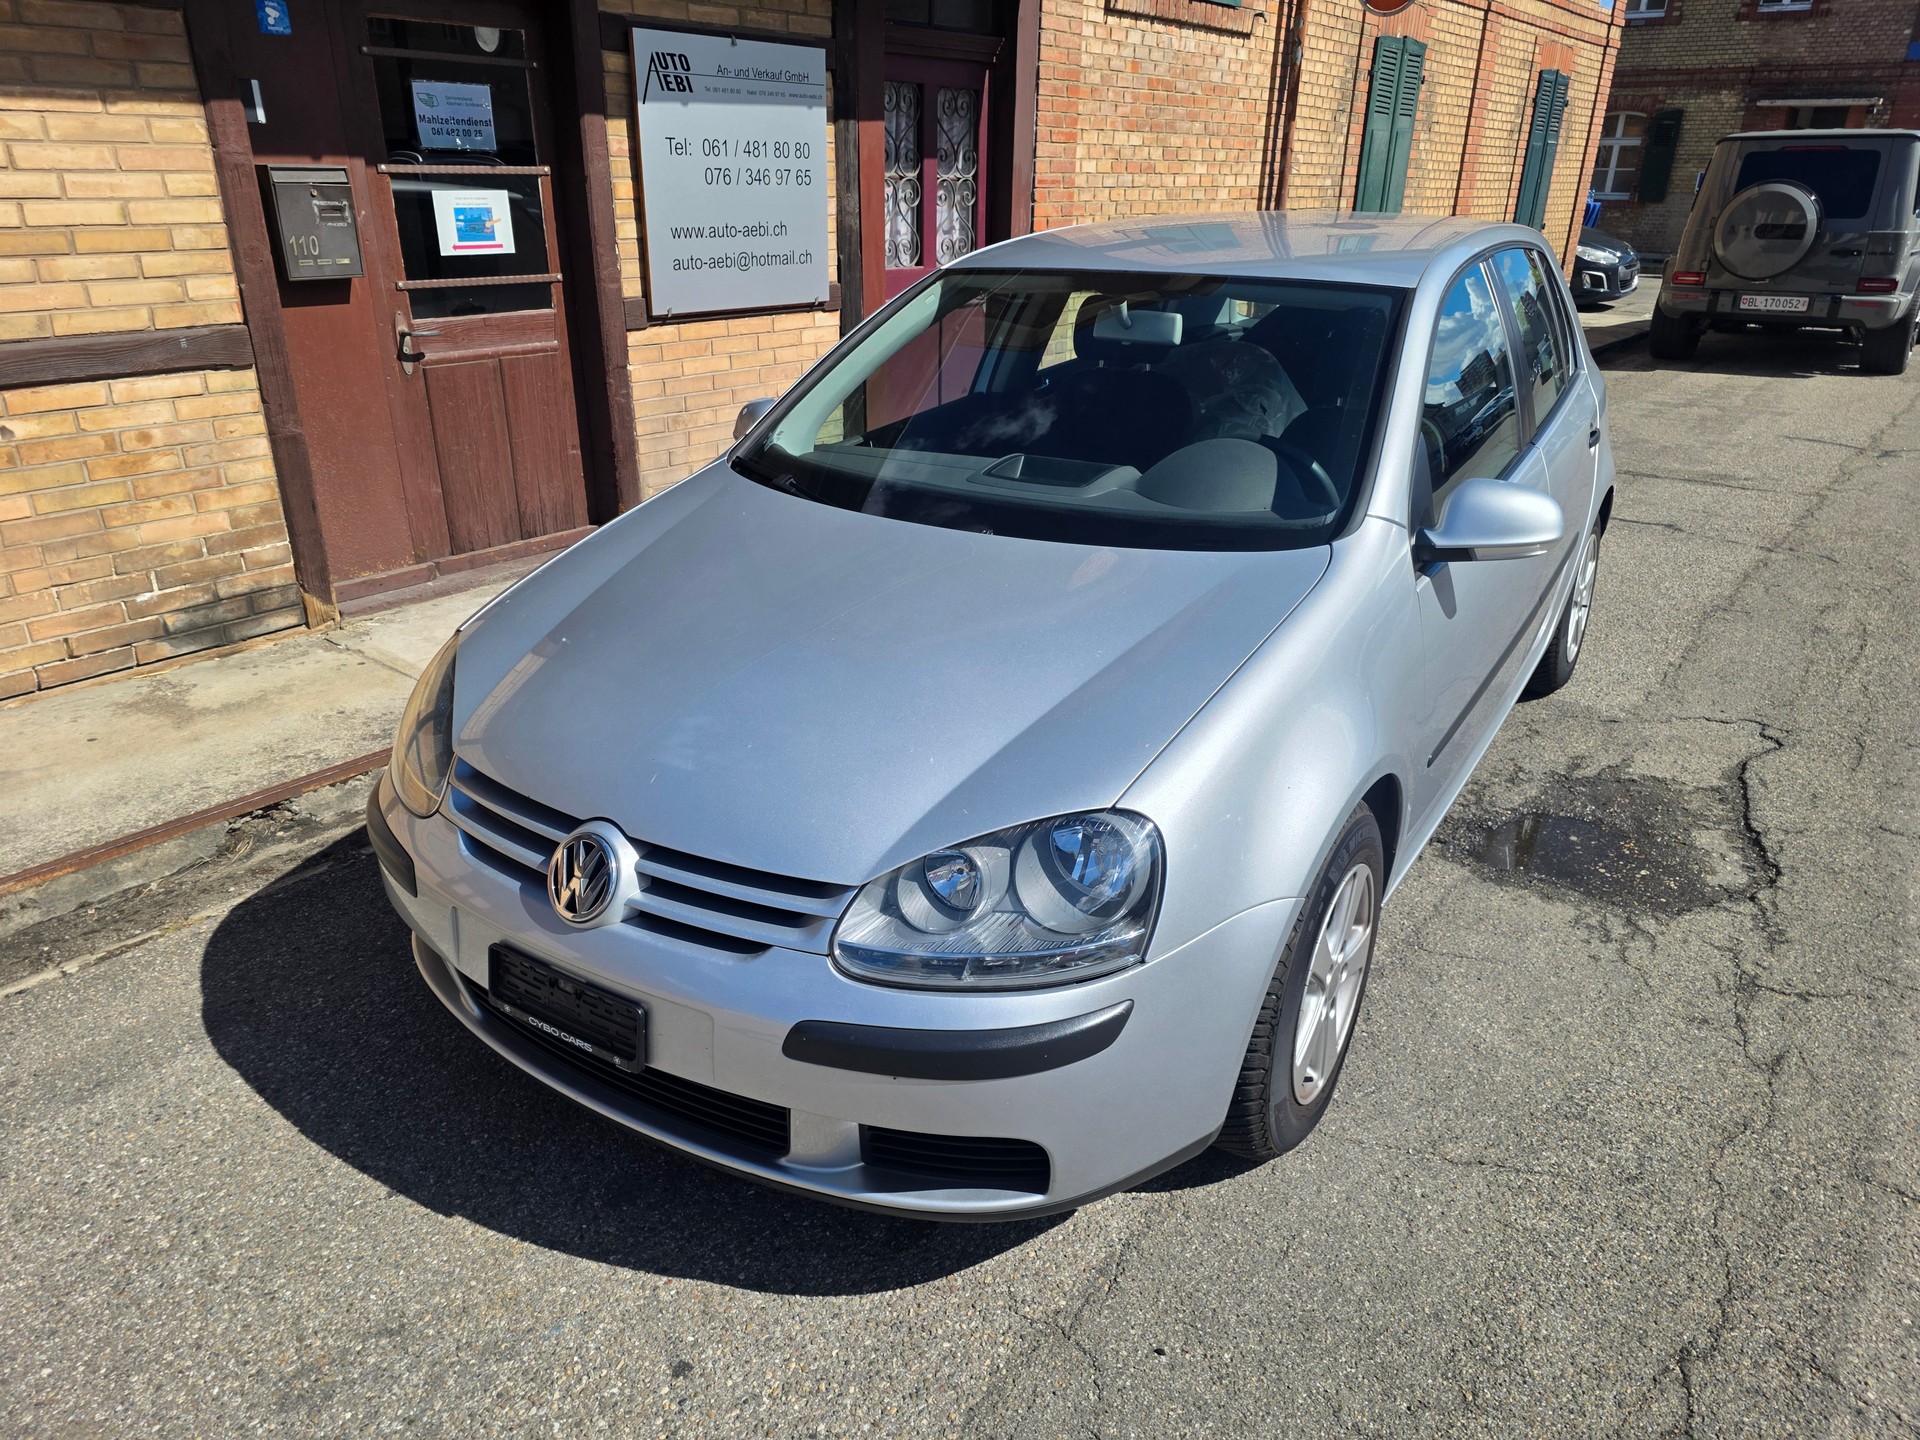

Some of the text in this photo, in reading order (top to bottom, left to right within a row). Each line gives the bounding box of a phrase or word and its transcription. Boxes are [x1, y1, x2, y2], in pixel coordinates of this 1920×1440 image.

[716, 64, 810, 83] An- und Verkauf GmbH
[419, 114, 493, 127] Mahlzeitendienst
[431, 127, 483, 137] 061 482 00 25
[665, 136, 811, 159] Tel: 061 / 481 80 80
[704, 167, 812, 186] 076 / 346 97 65
[670, 221, 788, 239] www.auto-aebi.ch
[289, 235, 319, 256] 110
[672, 250, 813, 271] auto-aebi@hotmail.ch
[528, 1016, 593, 1053] CYBO CARS
